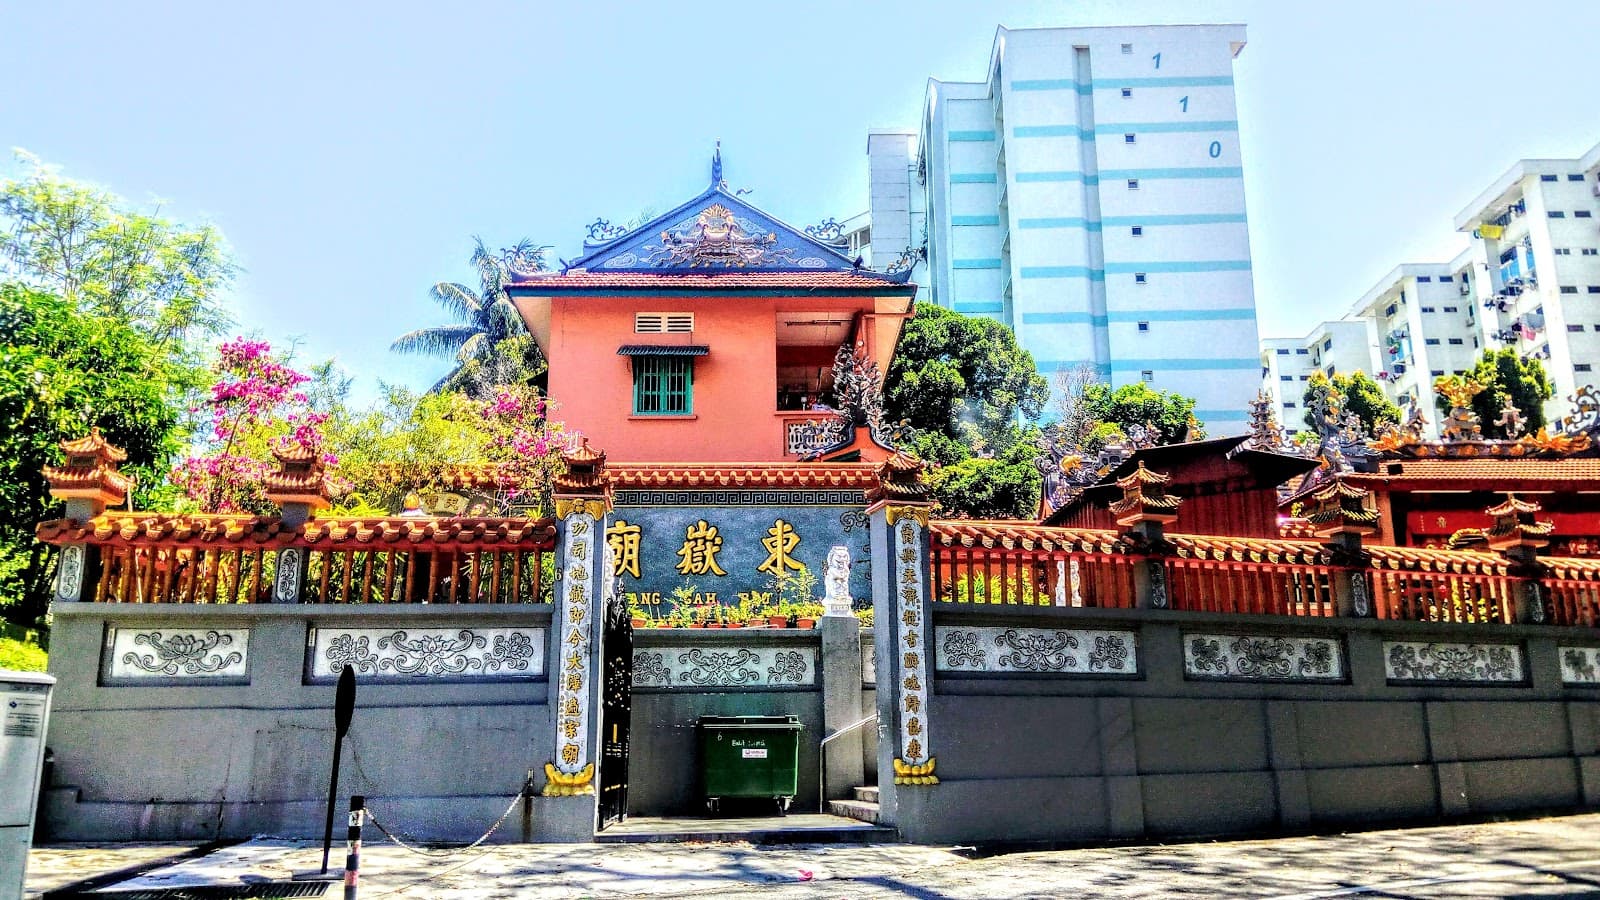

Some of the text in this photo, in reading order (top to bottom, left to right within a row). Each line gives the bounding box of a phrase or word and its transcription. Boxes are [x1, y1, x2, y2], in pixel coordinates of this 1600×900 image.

[1152, 52, 1222, 159] 1 1 0
